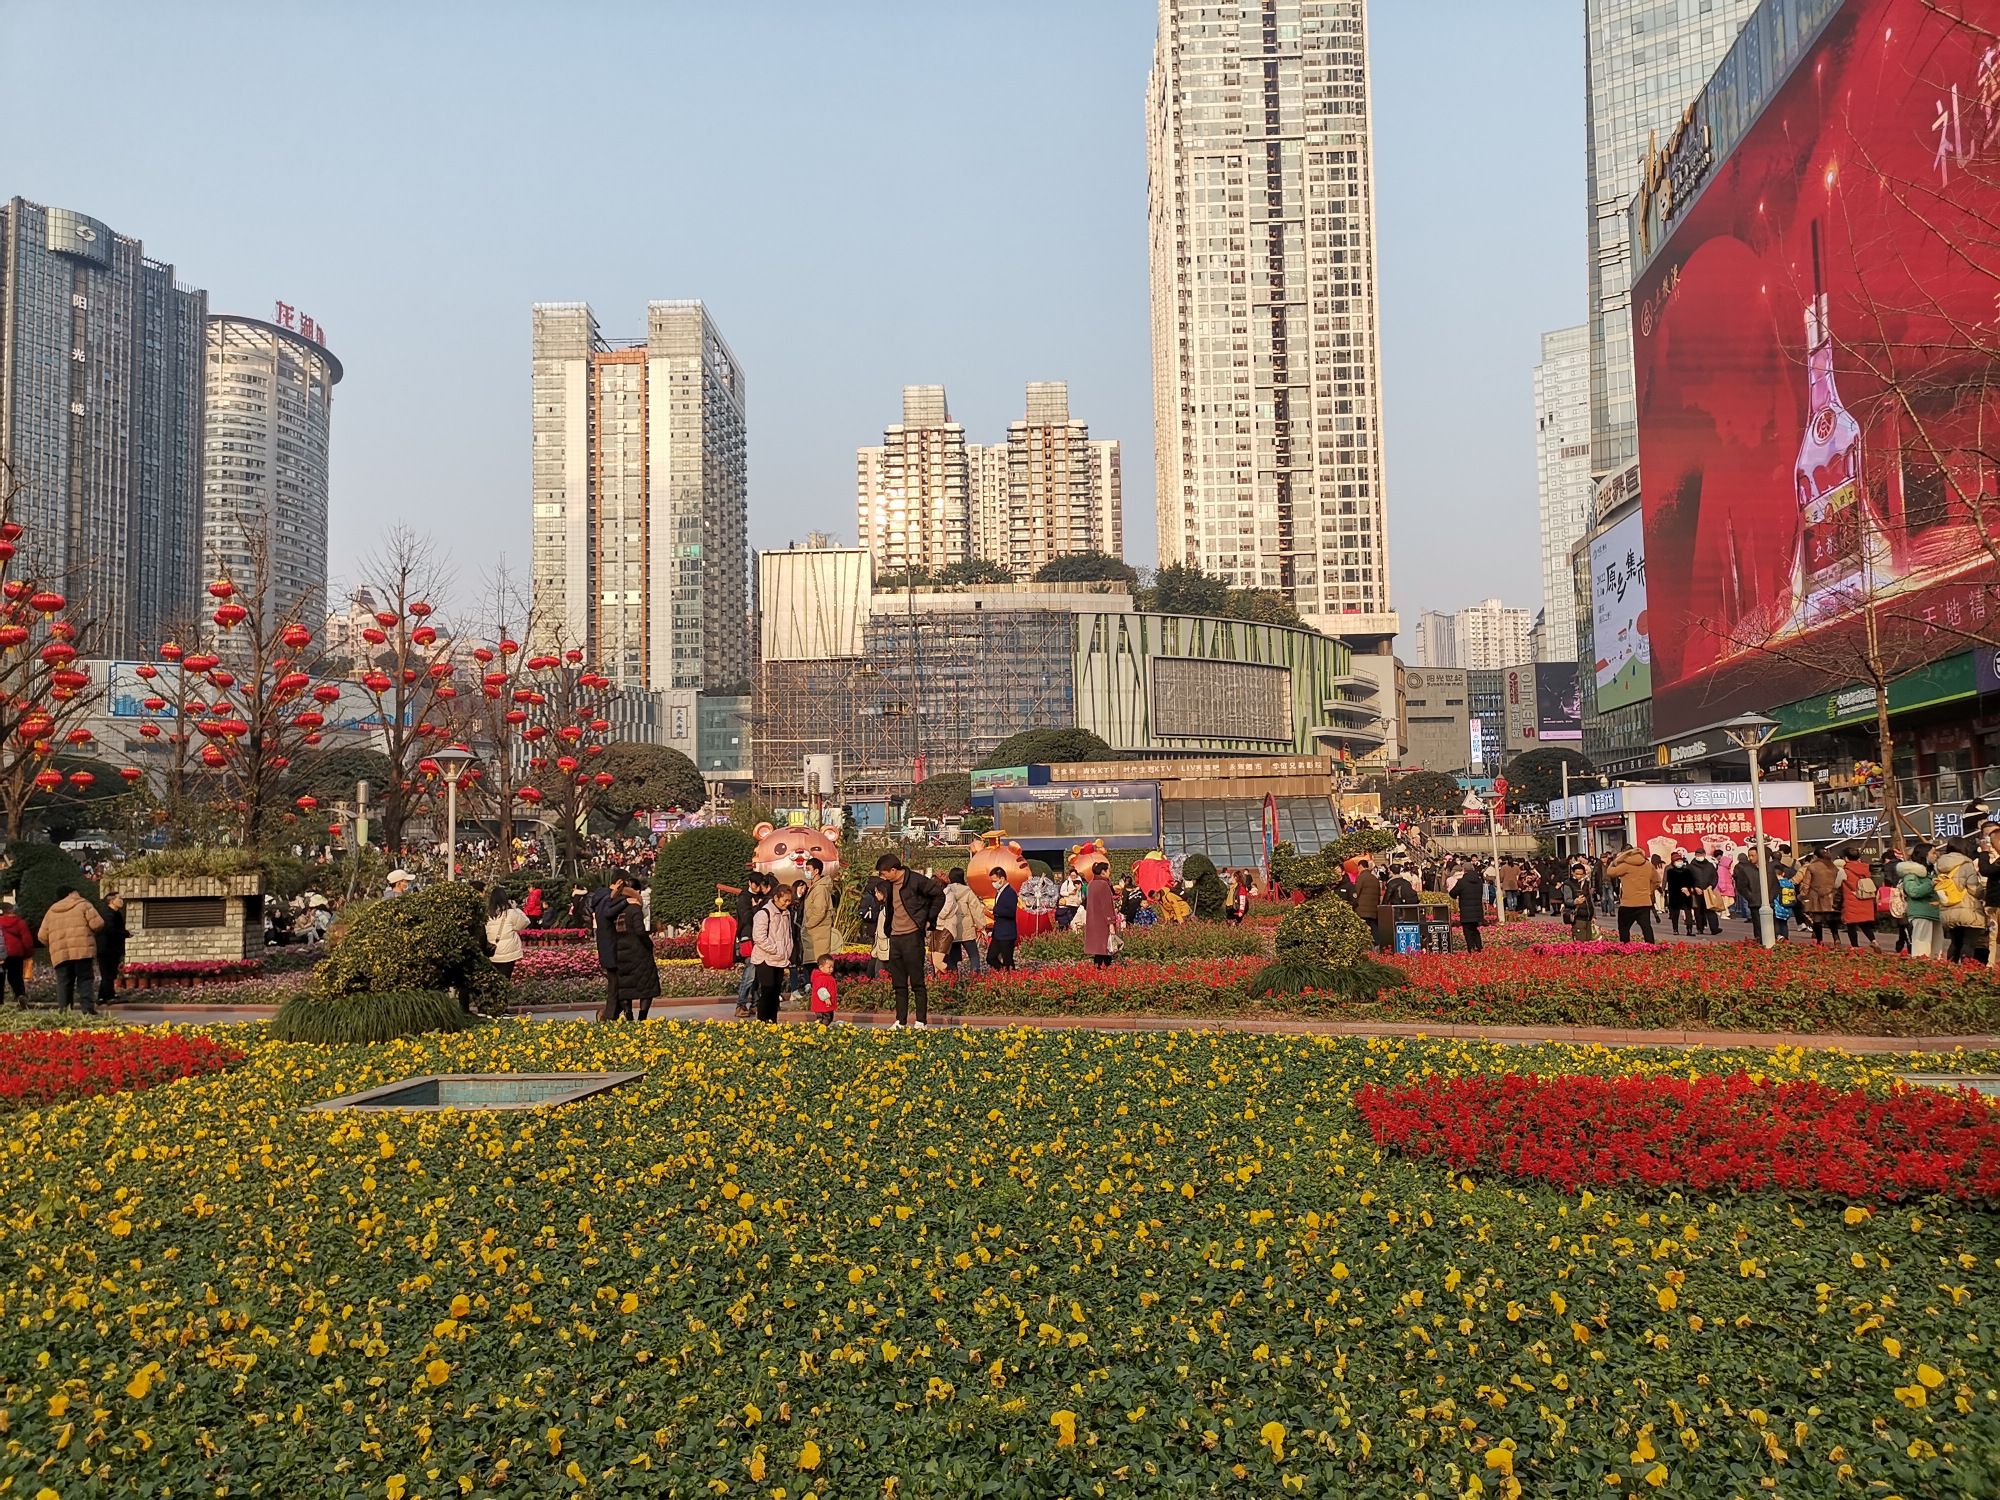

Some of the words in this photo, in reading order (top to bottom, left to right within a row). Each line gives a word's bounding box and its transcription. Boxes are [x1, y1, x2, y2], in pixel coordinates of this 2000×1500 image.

[72, 294, 87, 416] 阳光城
[1520, 672, 1536, 738] OUTLETS
[1671, 822, 1753, 835] 高质平价的美味
[1677, 813, 1745, 822] 让全球每个人享受
[1934, 813, 1964, 838] 美品
